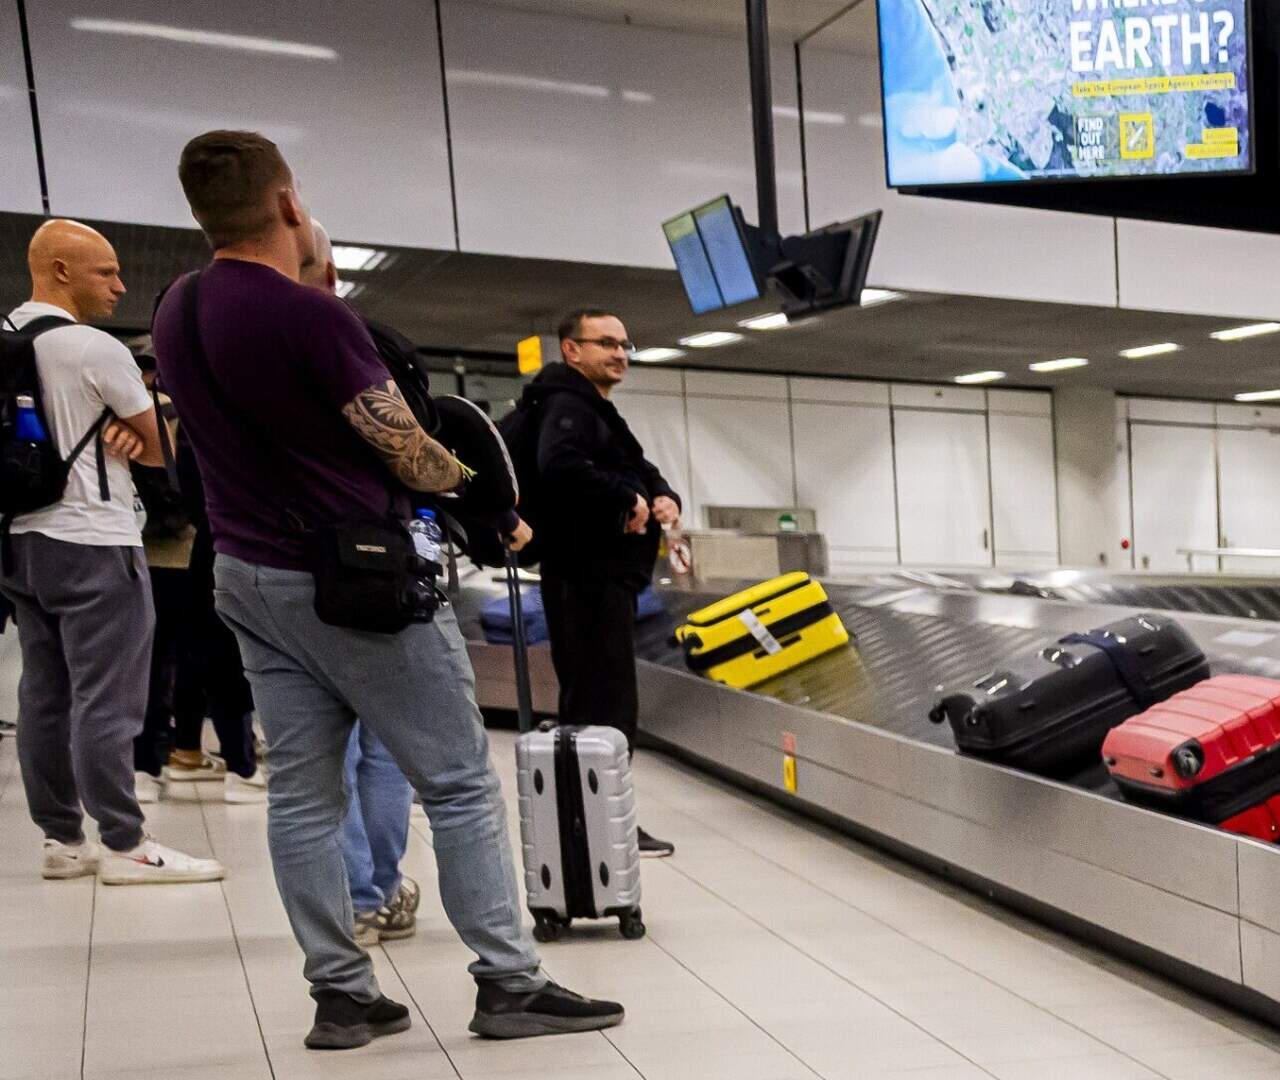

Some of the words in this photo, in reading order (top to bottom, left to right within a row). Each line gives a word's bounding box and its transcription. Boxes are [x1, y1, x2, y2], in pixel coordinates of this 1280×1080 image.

[1070, 10, 1235, 72] EARTH?
[1078, 117, 1103, 131] FIND
[1081, 132, 1101, 146] OUT
[1079, 145, 1105, 160] HERE
